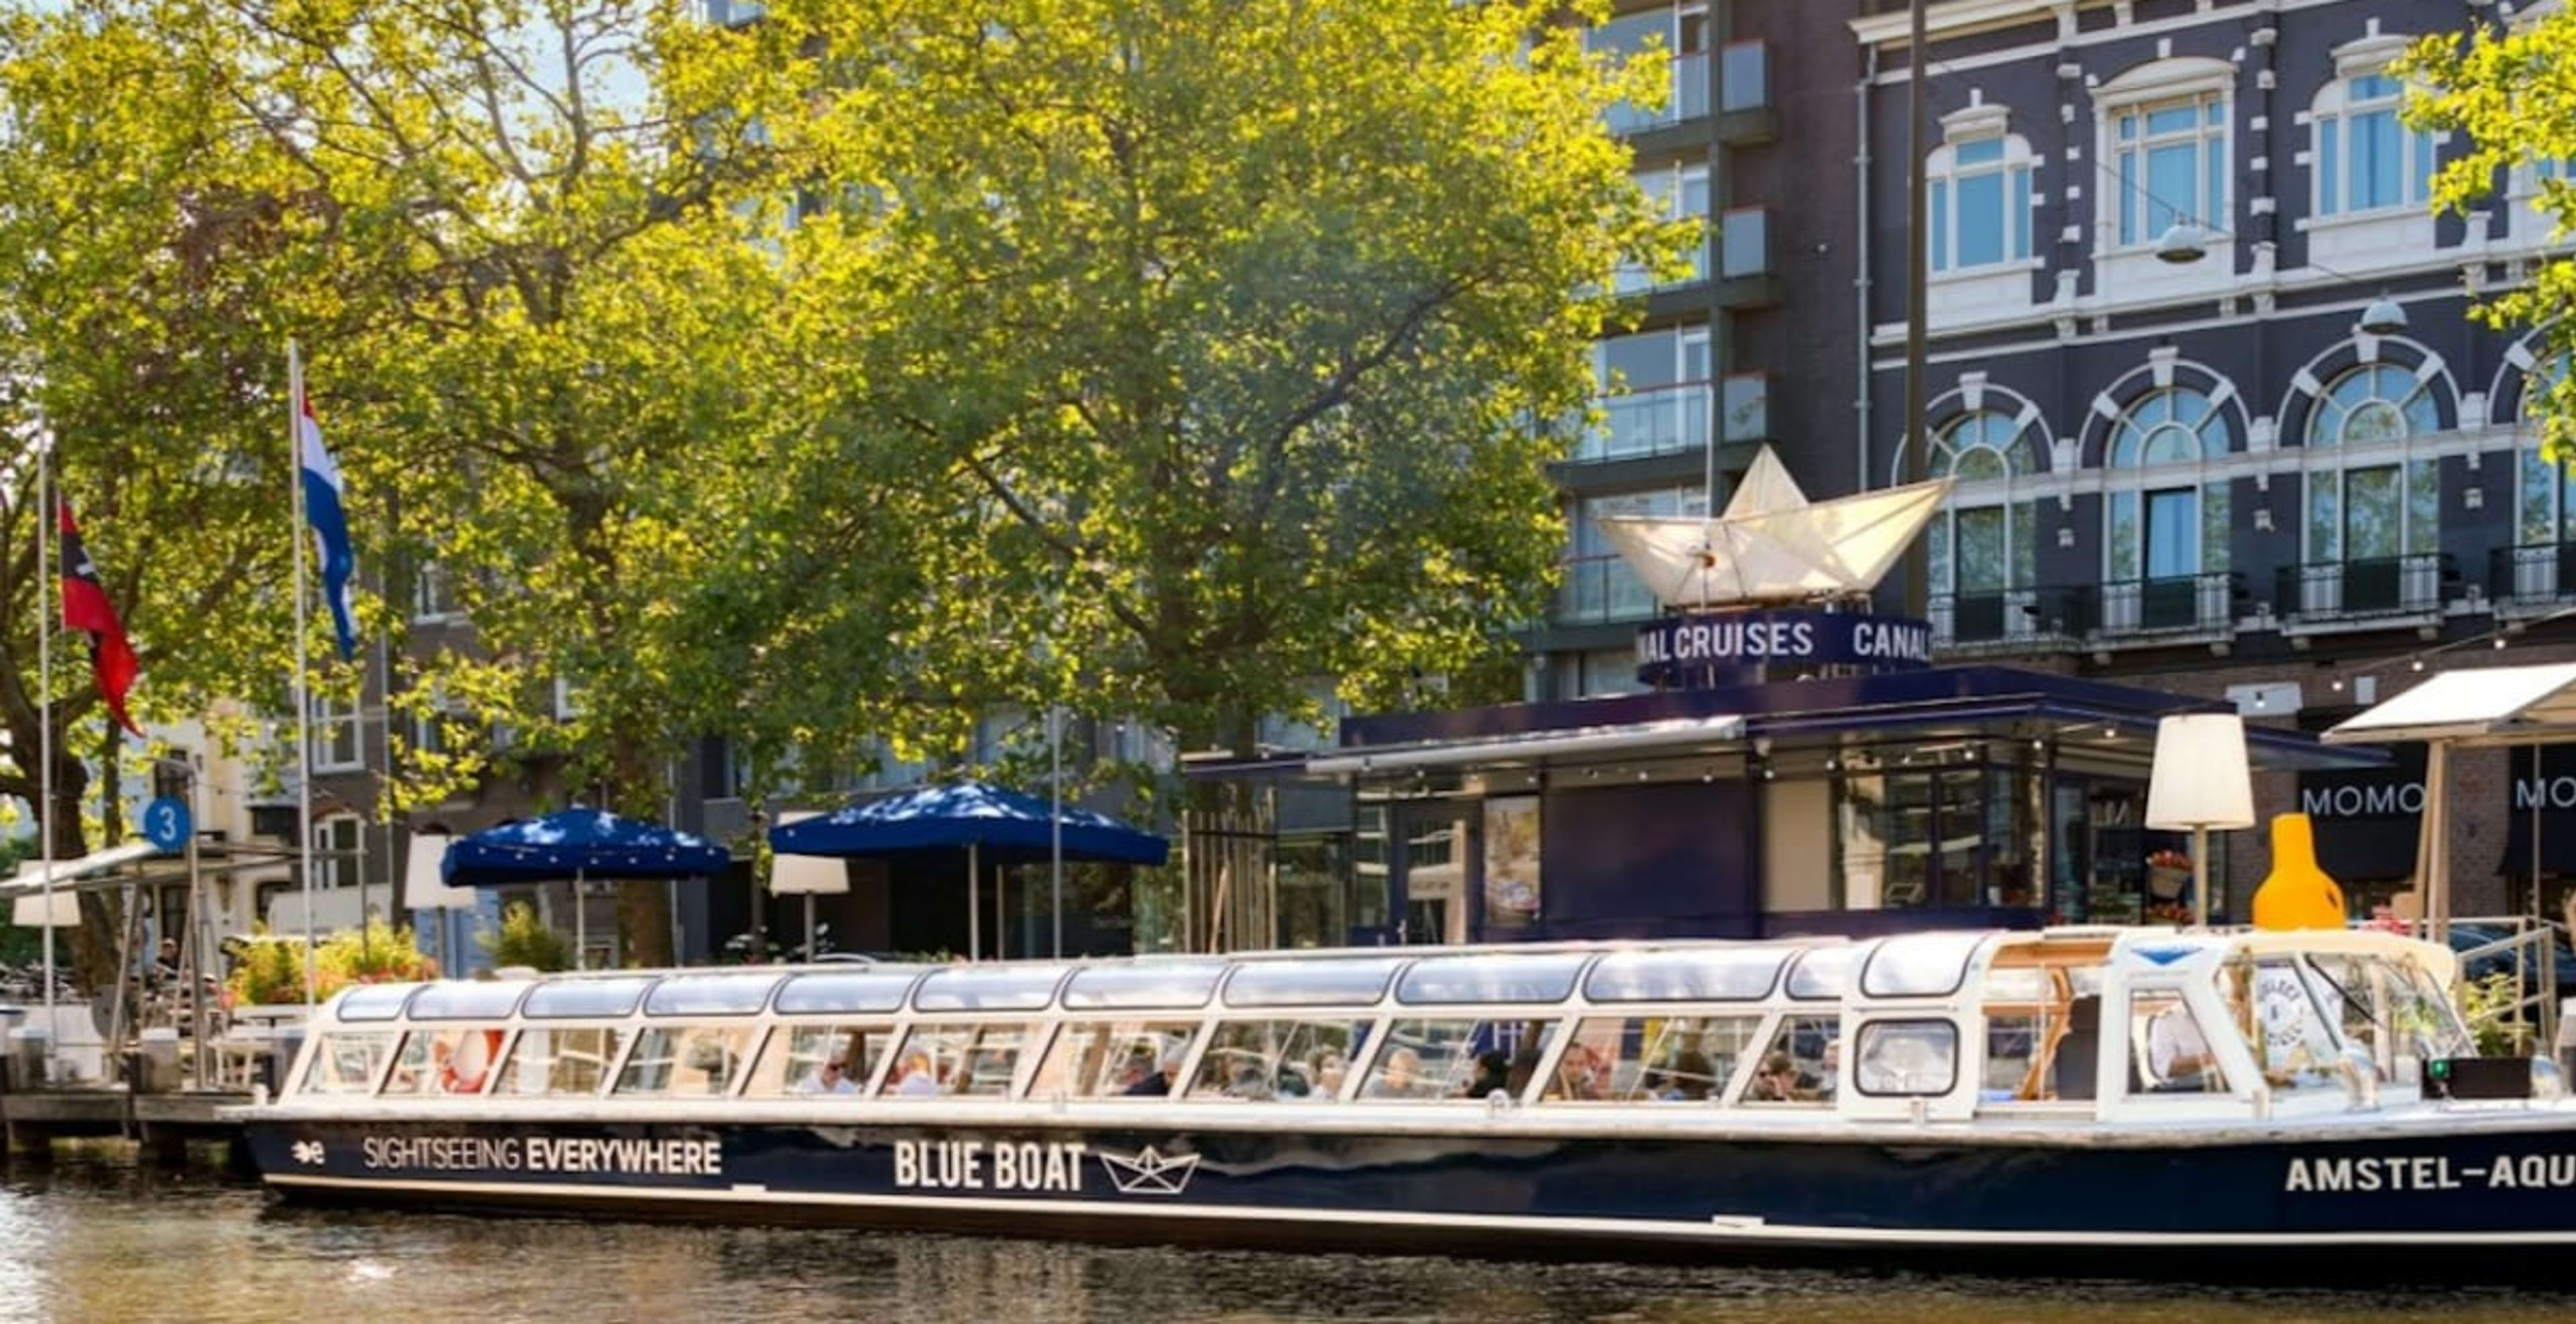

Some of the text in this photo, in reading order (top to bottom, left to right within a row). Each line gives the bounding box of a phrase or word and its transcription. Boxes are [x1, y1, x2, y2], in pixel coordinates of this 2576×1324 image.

[1674, 622, 1813, 659] CRUISES
[2302, 782, 2425, 816] MOMO
[2516, 776, 2576, 809] MO
[159, 806, 176, 841] 3
[363, 1136, 722, 1174] SIGHTSEEING EVERYWHERE
[894, 1140, 1087, 1191] BLUE BOAT
[2286, 1155, 2576, 1191] AMSTEL-AQU
